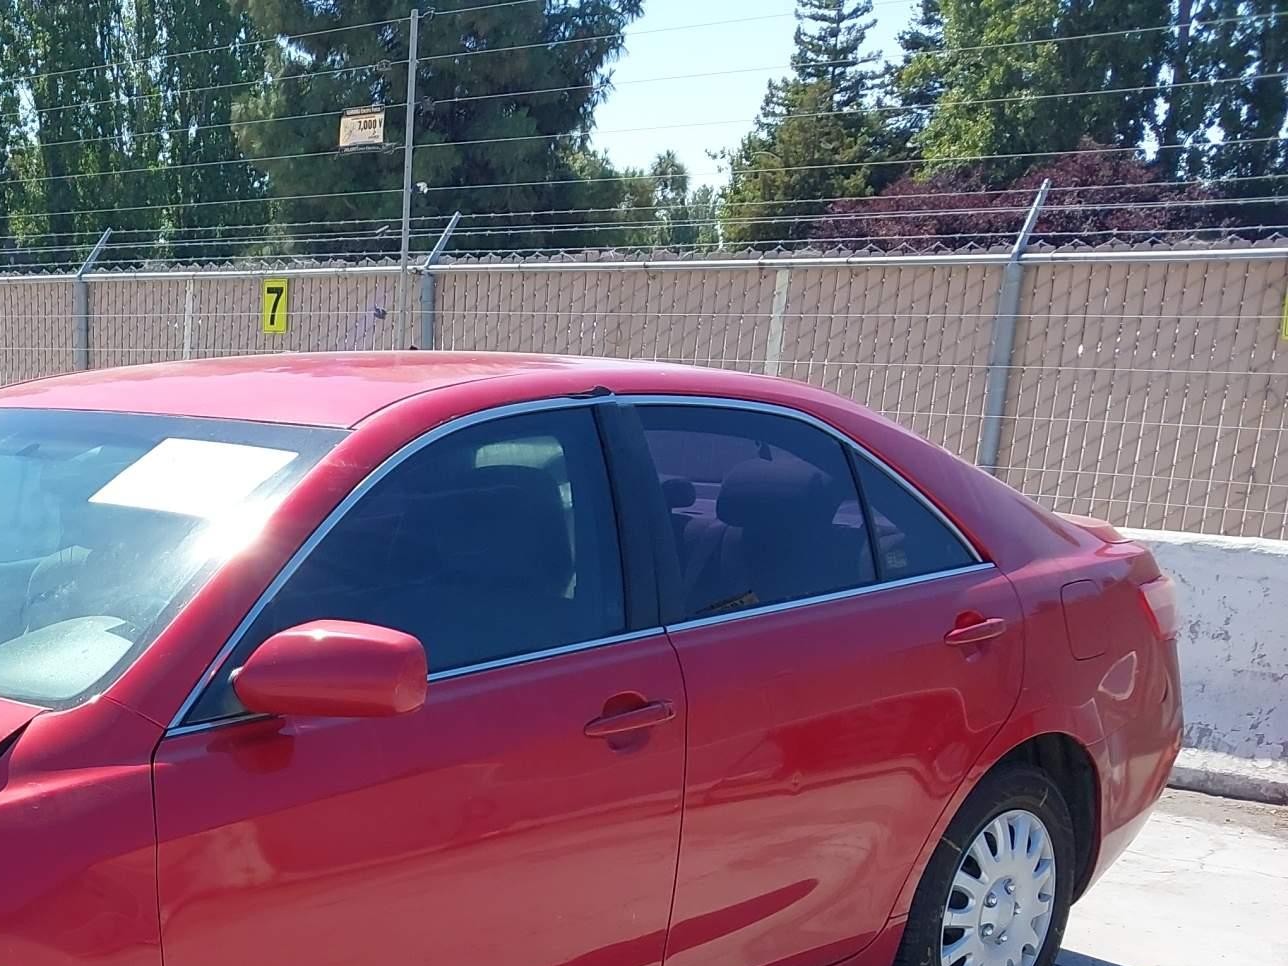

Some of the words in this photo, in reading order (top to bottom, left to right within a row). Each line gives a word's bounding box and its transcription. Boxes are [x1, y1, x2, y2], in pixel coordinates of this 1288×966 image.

[358, 119, 377, 132] 7,000
[379, 118, 384, 128] V
[266, 286, 284, 326] 7
